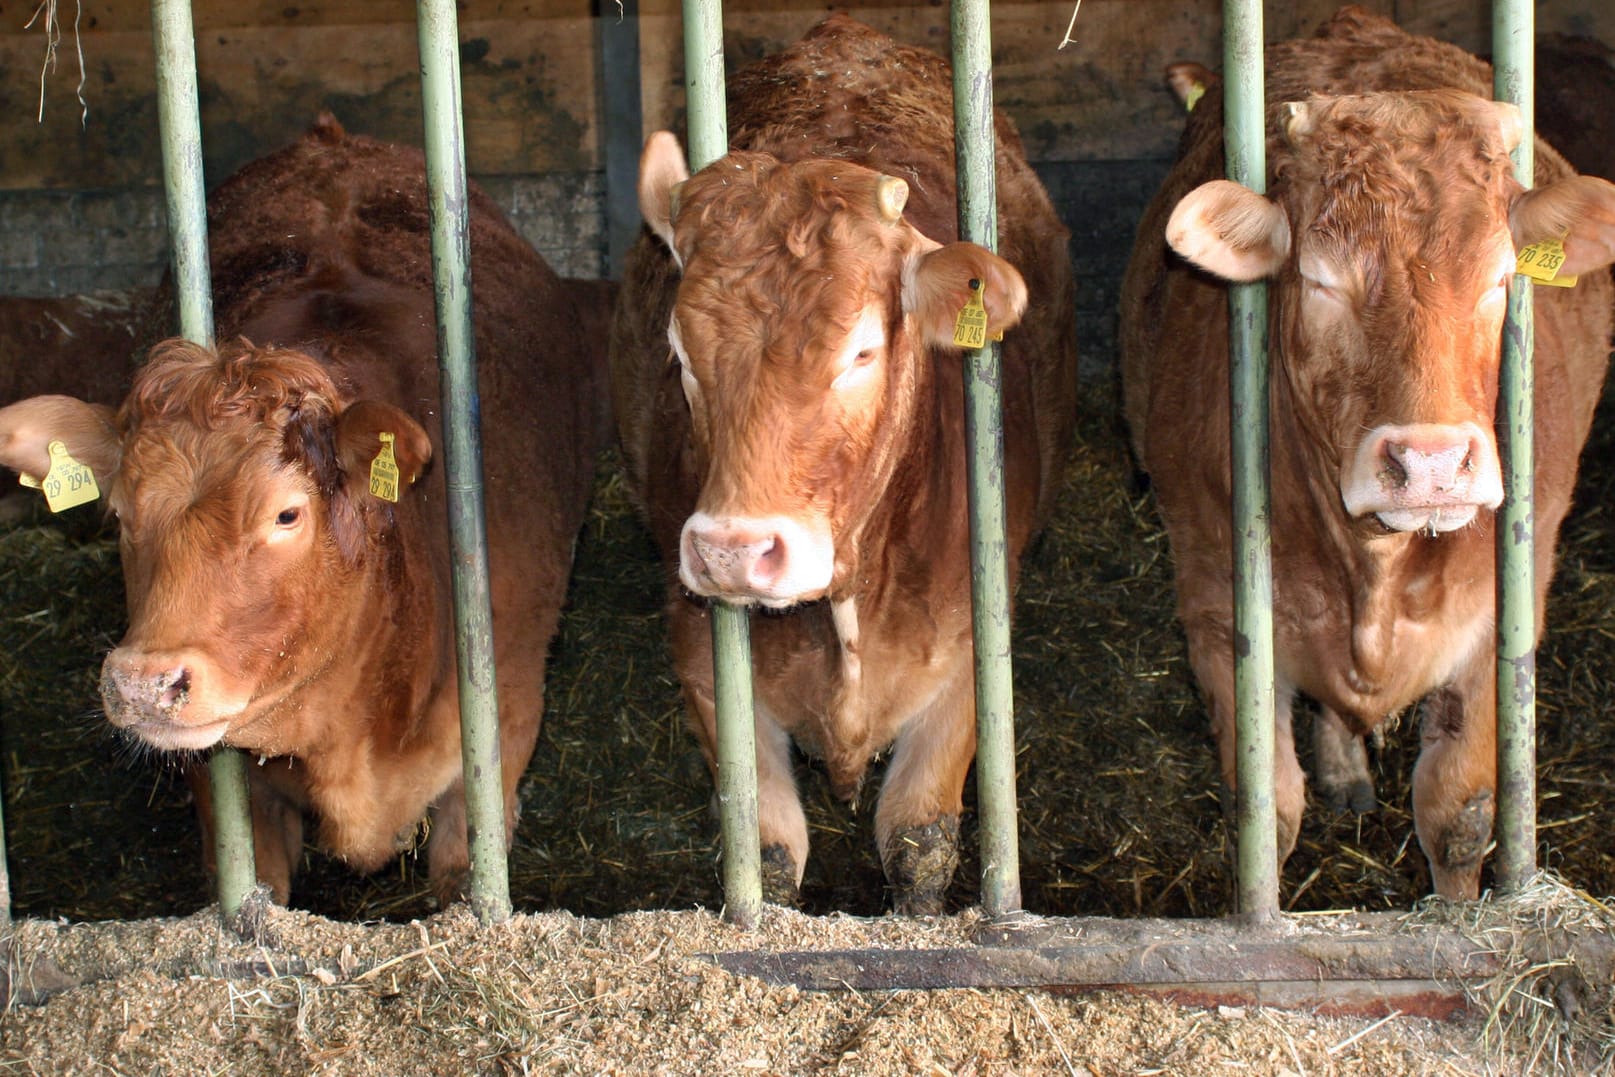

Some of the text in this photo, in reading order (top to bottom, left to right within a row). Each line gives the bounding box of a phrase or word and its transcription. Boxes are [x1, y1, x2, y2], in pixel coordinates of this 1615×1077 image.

[1517, 248, 1563, 269] 70 235
[954, 324, 984, 344] 70 245
[46, 480, 62, 498] 29
[67, 470, 92, 491] 294
